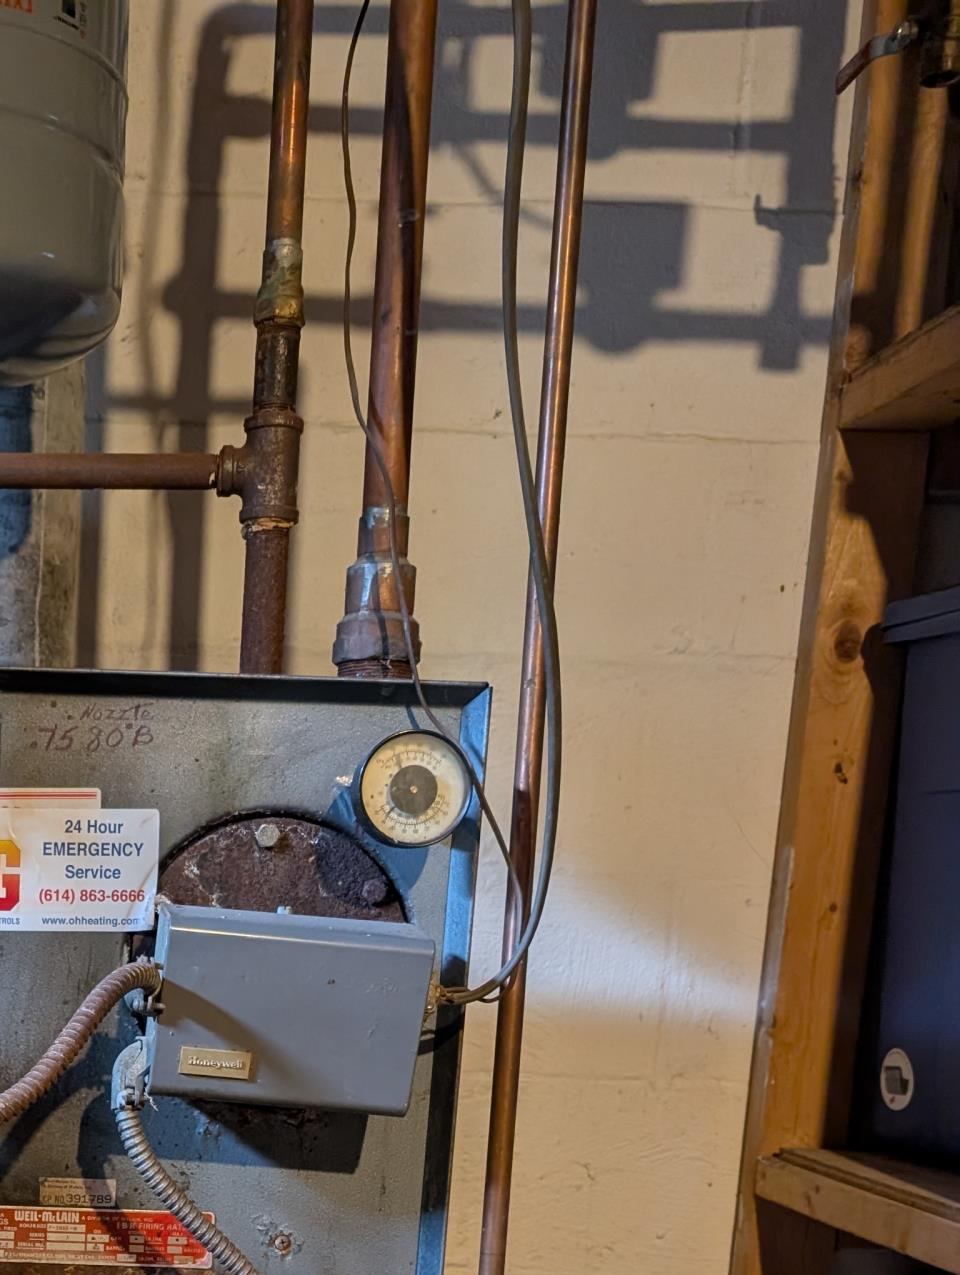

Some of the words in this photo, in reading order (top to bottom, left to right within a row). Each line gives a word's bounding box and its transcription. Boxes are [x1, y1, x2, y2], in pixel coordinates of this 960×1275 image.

[64, 820, 83, 834] 24
[87, 820, 124, 835] Hour
[42, 842, 144, 857] EMERGENCY
[65, 865, 121, 880] Service
[38, 888, 76, 905] (614)
[79, 888, 145, 904] 863-6666
[187, 1055, 244, 1069] Honeywell
[66, 1193, 112, 1204] 391789
[138, 1222, 165, 1231] FIRING
